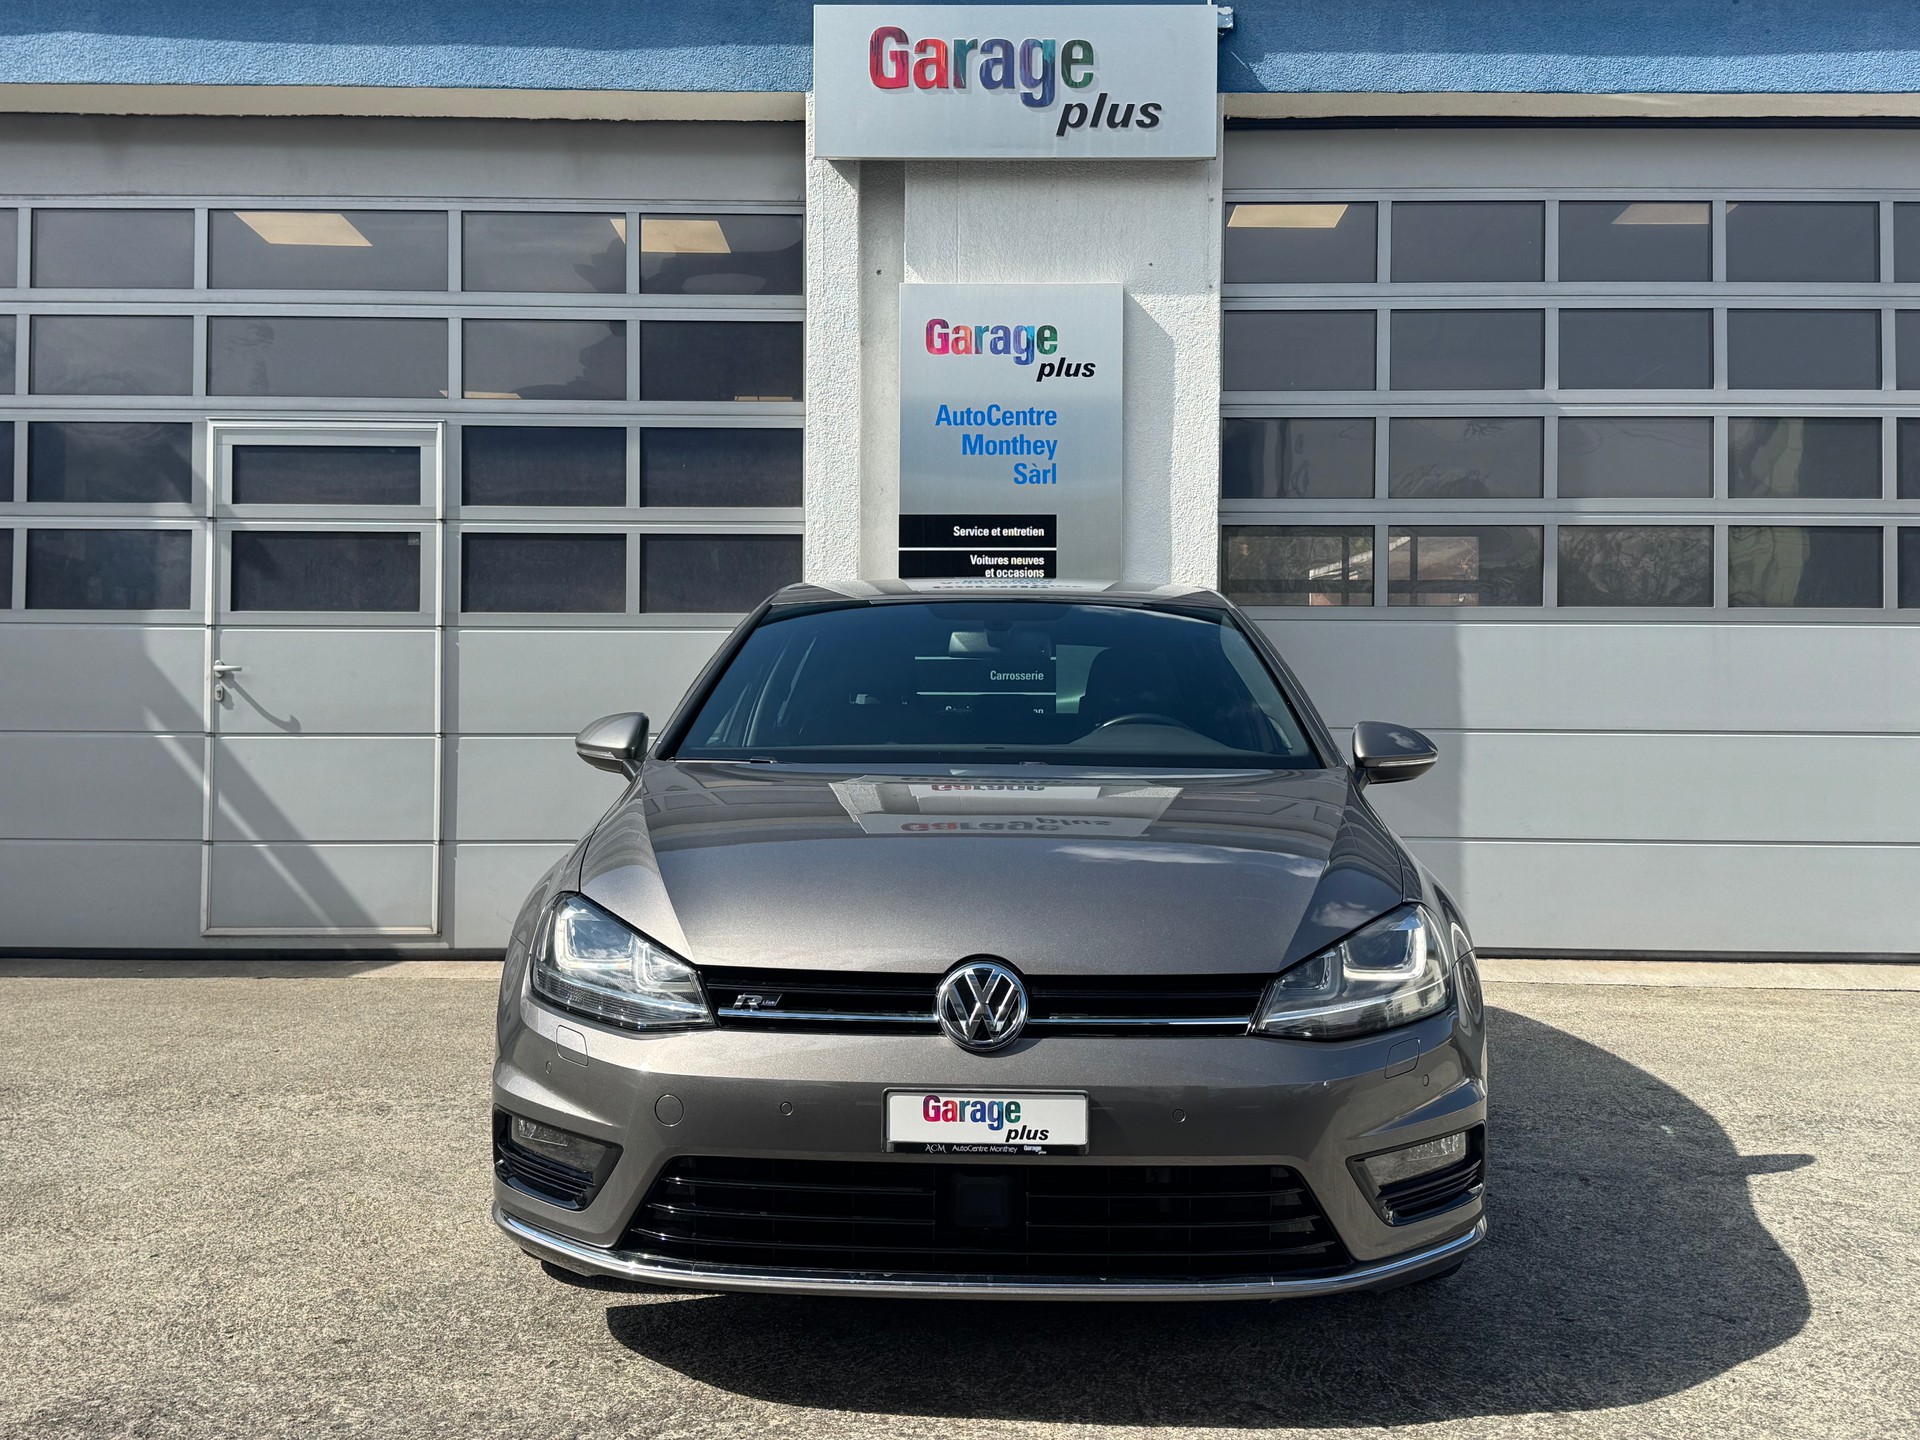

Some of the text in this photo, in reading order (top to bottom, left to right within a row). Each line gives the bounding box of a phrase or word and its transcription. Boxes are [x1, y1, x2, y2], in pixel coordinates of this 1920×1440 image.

[869, 26, 1094, 107] Garage
[1056, 92, 1162, 137] plus
[925, 318, 1058, 365] Garage
[1036, 357, 1096, 382] plus
[935, 404, 1057, 426] AutoCentre
[962, 434, 1058, 460] Monthey
[1013, 463, 1057, 484] Sàrl
[953, 525, 1045, 537] Service et entretien
[970, 554, 1045, 565] Voitures neuves
[985, 566, 1045, 578] et occasions
[990, 670, 1044, 681] Carrosserie
[733, 994, 763, 1009] R
[922, 1095, 1021, 1131] Garage
[1005, 1125, 1050, 1142] plus
[925, 1144, 1018, 1153] ACM AutoCentre Monthey
